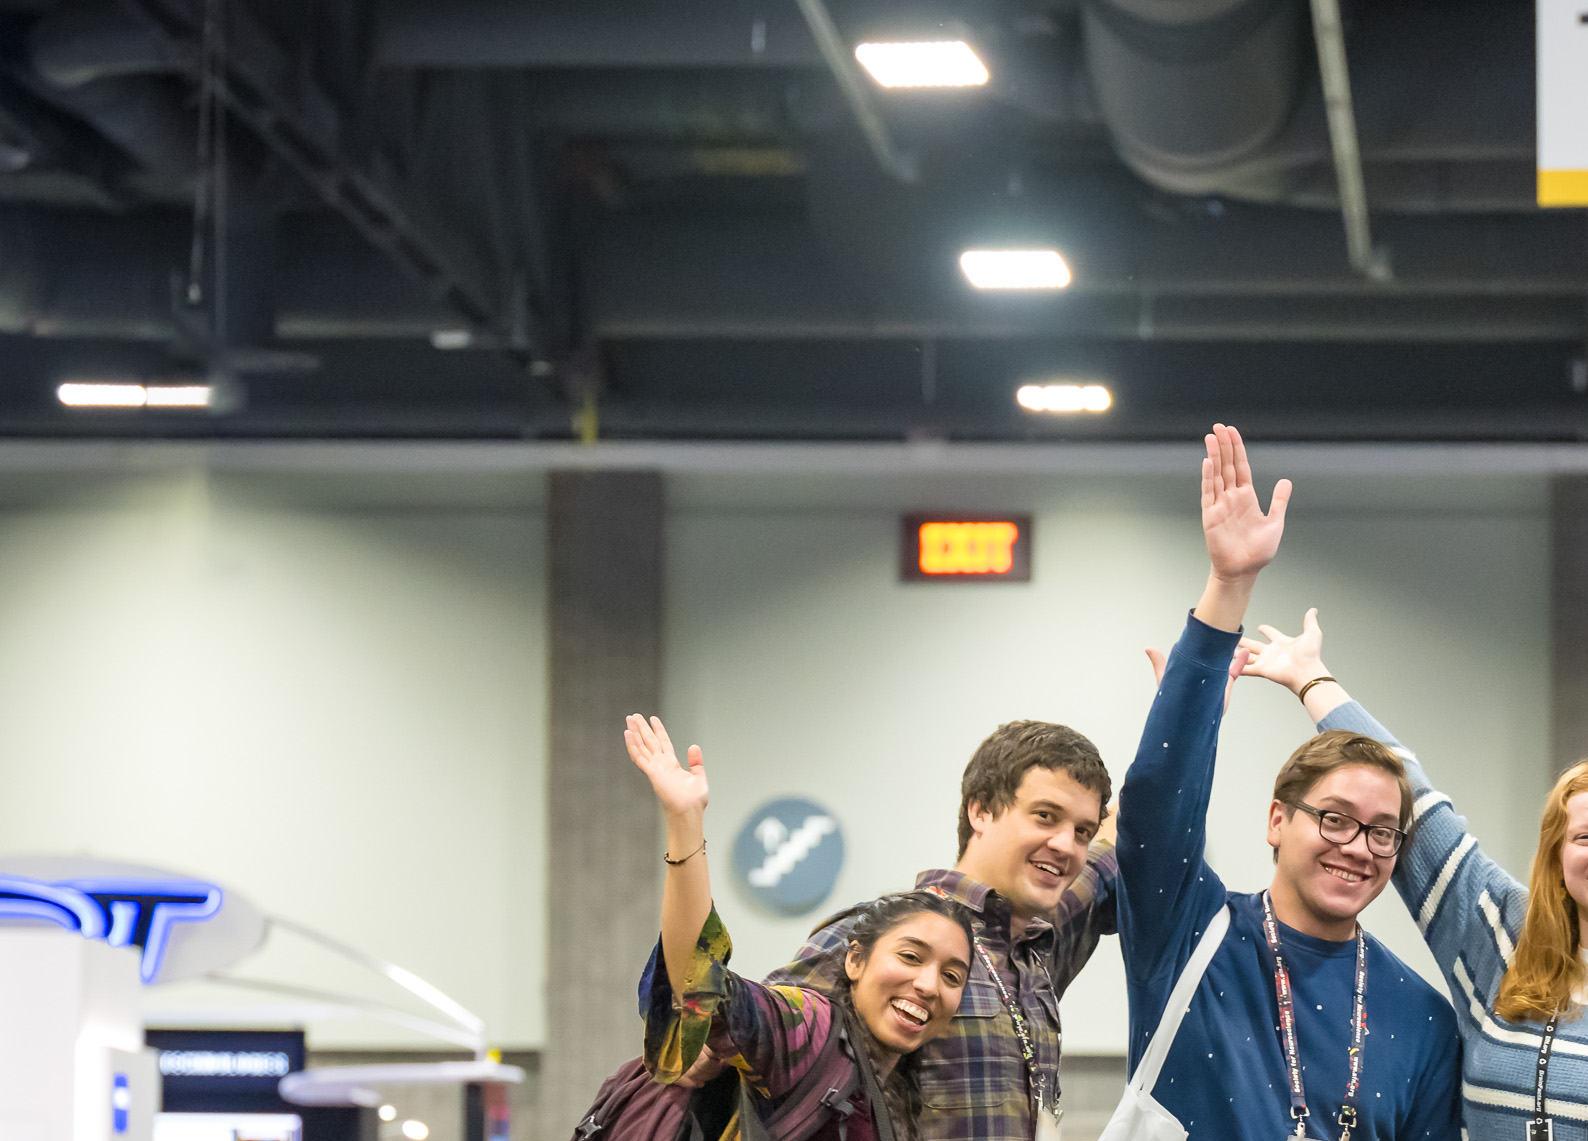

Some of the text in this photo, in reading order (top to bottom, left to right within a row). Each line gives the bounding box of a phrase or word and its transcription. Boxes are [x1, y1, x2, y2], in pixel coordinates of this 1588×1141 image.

[1356, 970, 1365, 993] Society
[1284, 1010, 1296, 1056] Neuroscience
[1291, 1067, 1301, 1093] Society
